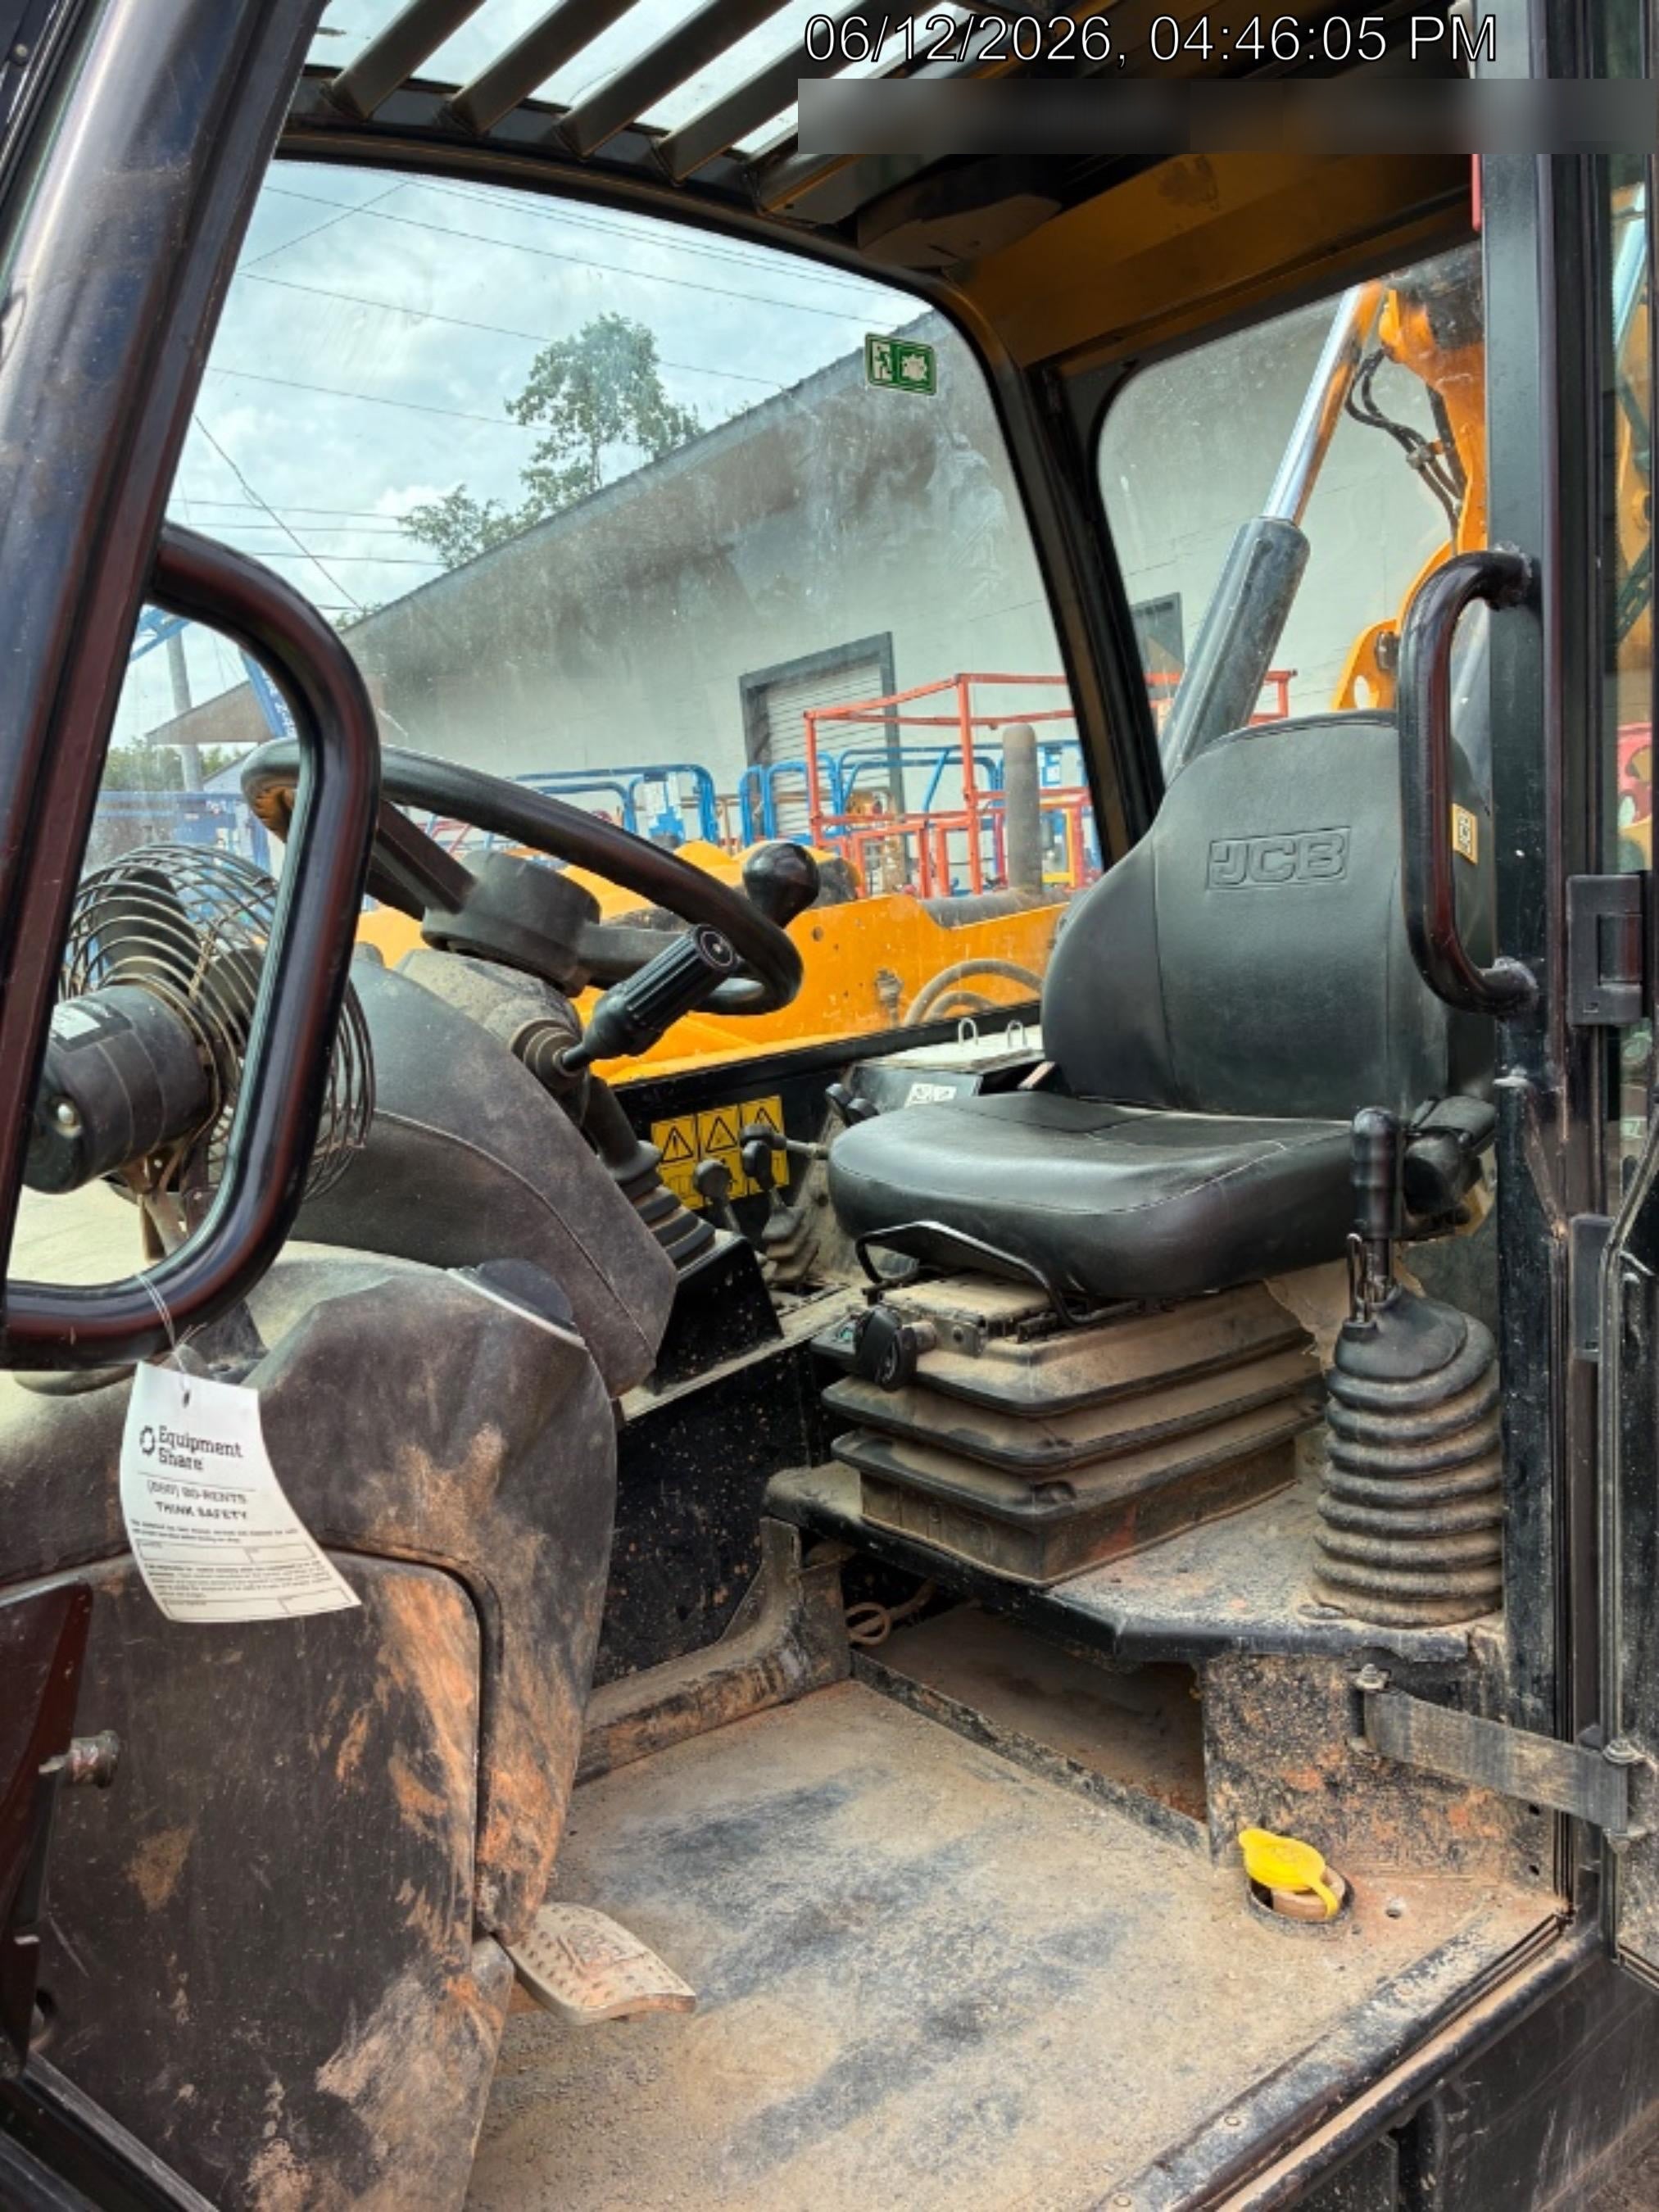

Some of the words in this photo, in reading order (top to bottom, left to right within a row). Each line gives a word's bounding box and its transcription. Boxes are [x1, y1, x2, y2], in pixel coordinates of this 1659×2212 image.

[1209, 831, 1347, 886] JCB
[158, 1425, 243, 1457] Equipment
[158, 1448, 203, 1471] Share
